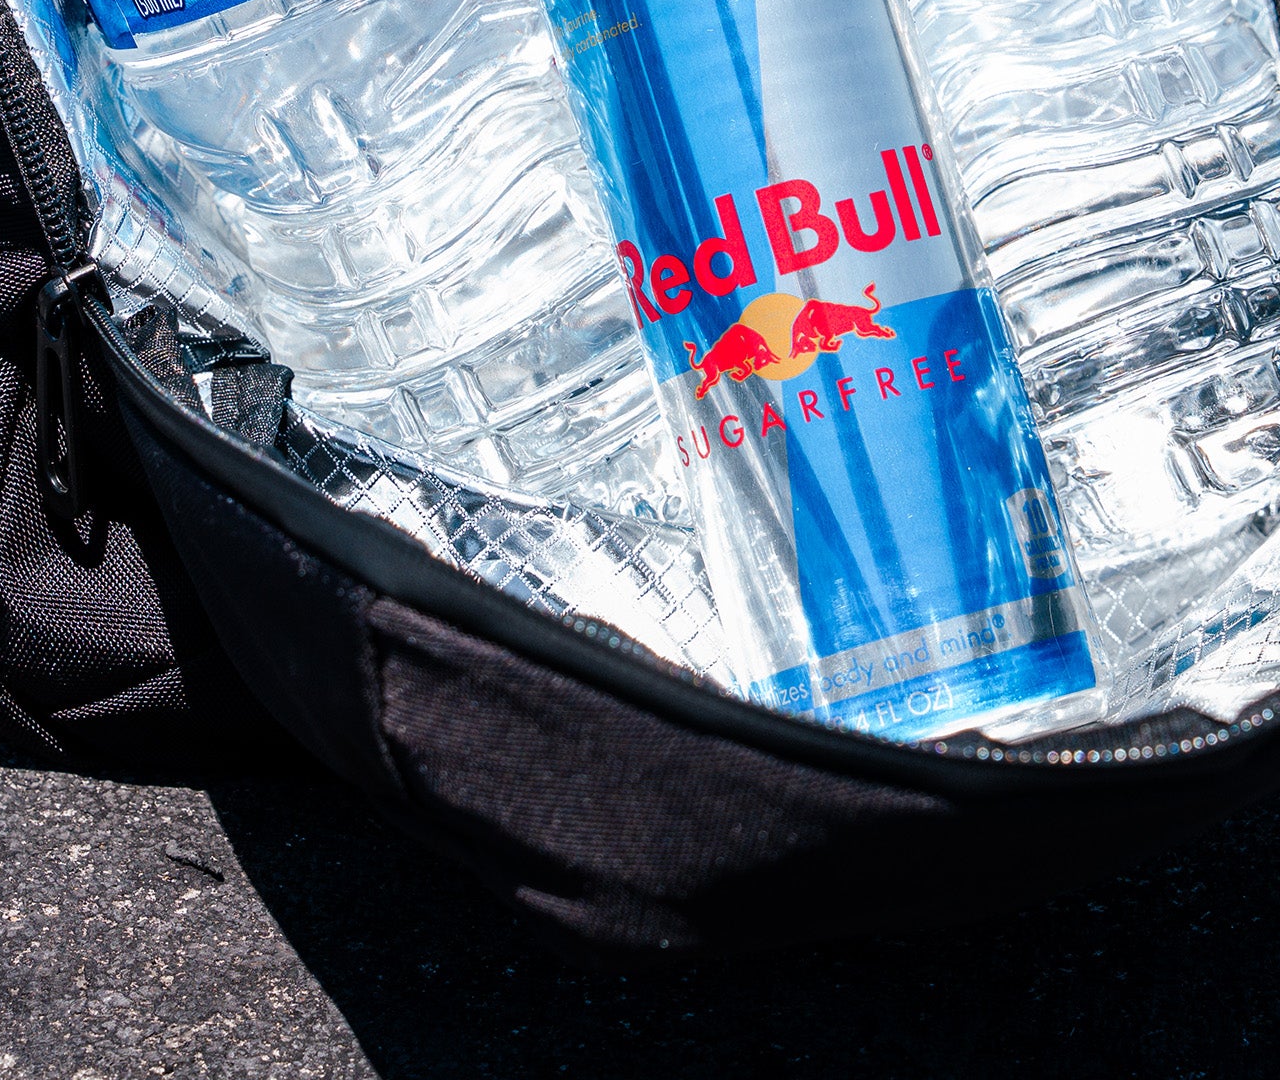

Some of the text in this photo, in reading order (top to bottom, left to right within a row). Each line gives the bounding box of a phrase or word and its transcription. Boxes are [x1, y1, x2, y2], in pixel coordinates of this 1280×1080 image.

[617, 193, 758, 331] Red
[1022, 498, 1049, 535] 10
[816, 656, 874, 692] body
[883, 638, 930, 674] and
[876, 700, 902, 728] FL
[907, 683, 953, 717] OZ)
